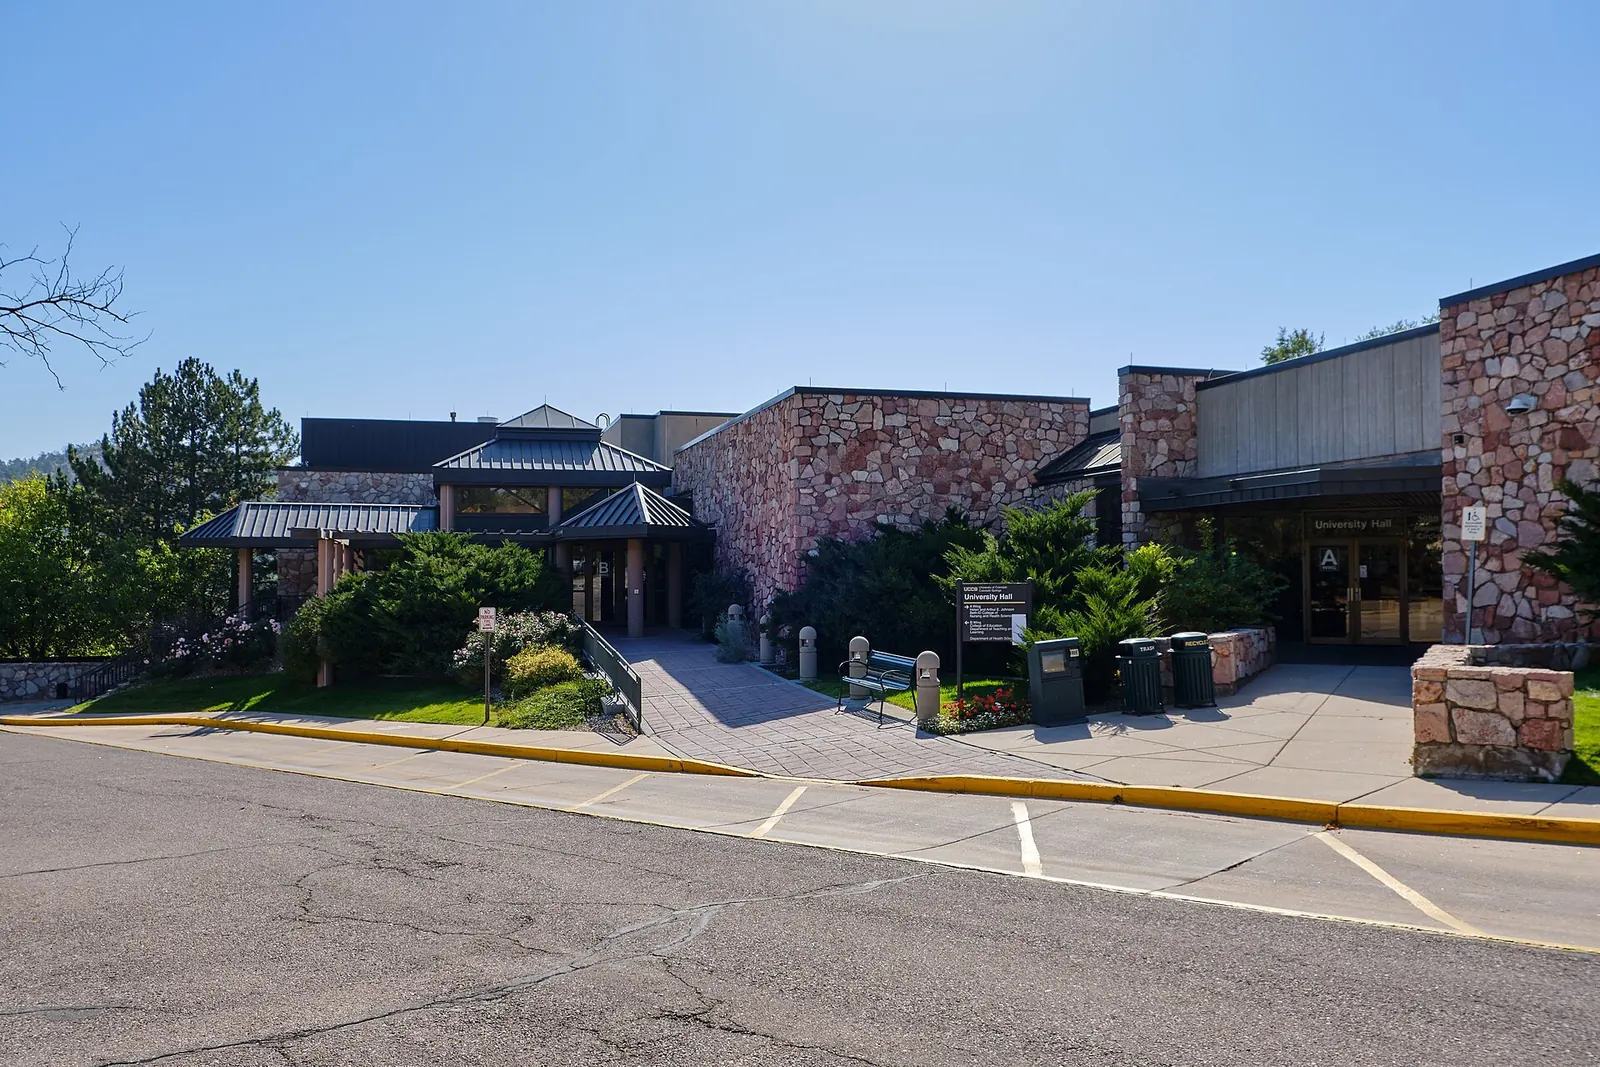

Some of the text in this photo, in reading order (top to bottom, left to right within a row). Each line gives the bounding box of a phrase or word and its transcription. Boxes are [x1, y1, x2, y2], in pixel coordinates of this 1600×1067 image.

[1315, 519, 1392, 530] University Hall
[1321, 549, 1338, 566] A
[599, 561, 609, 573] B
